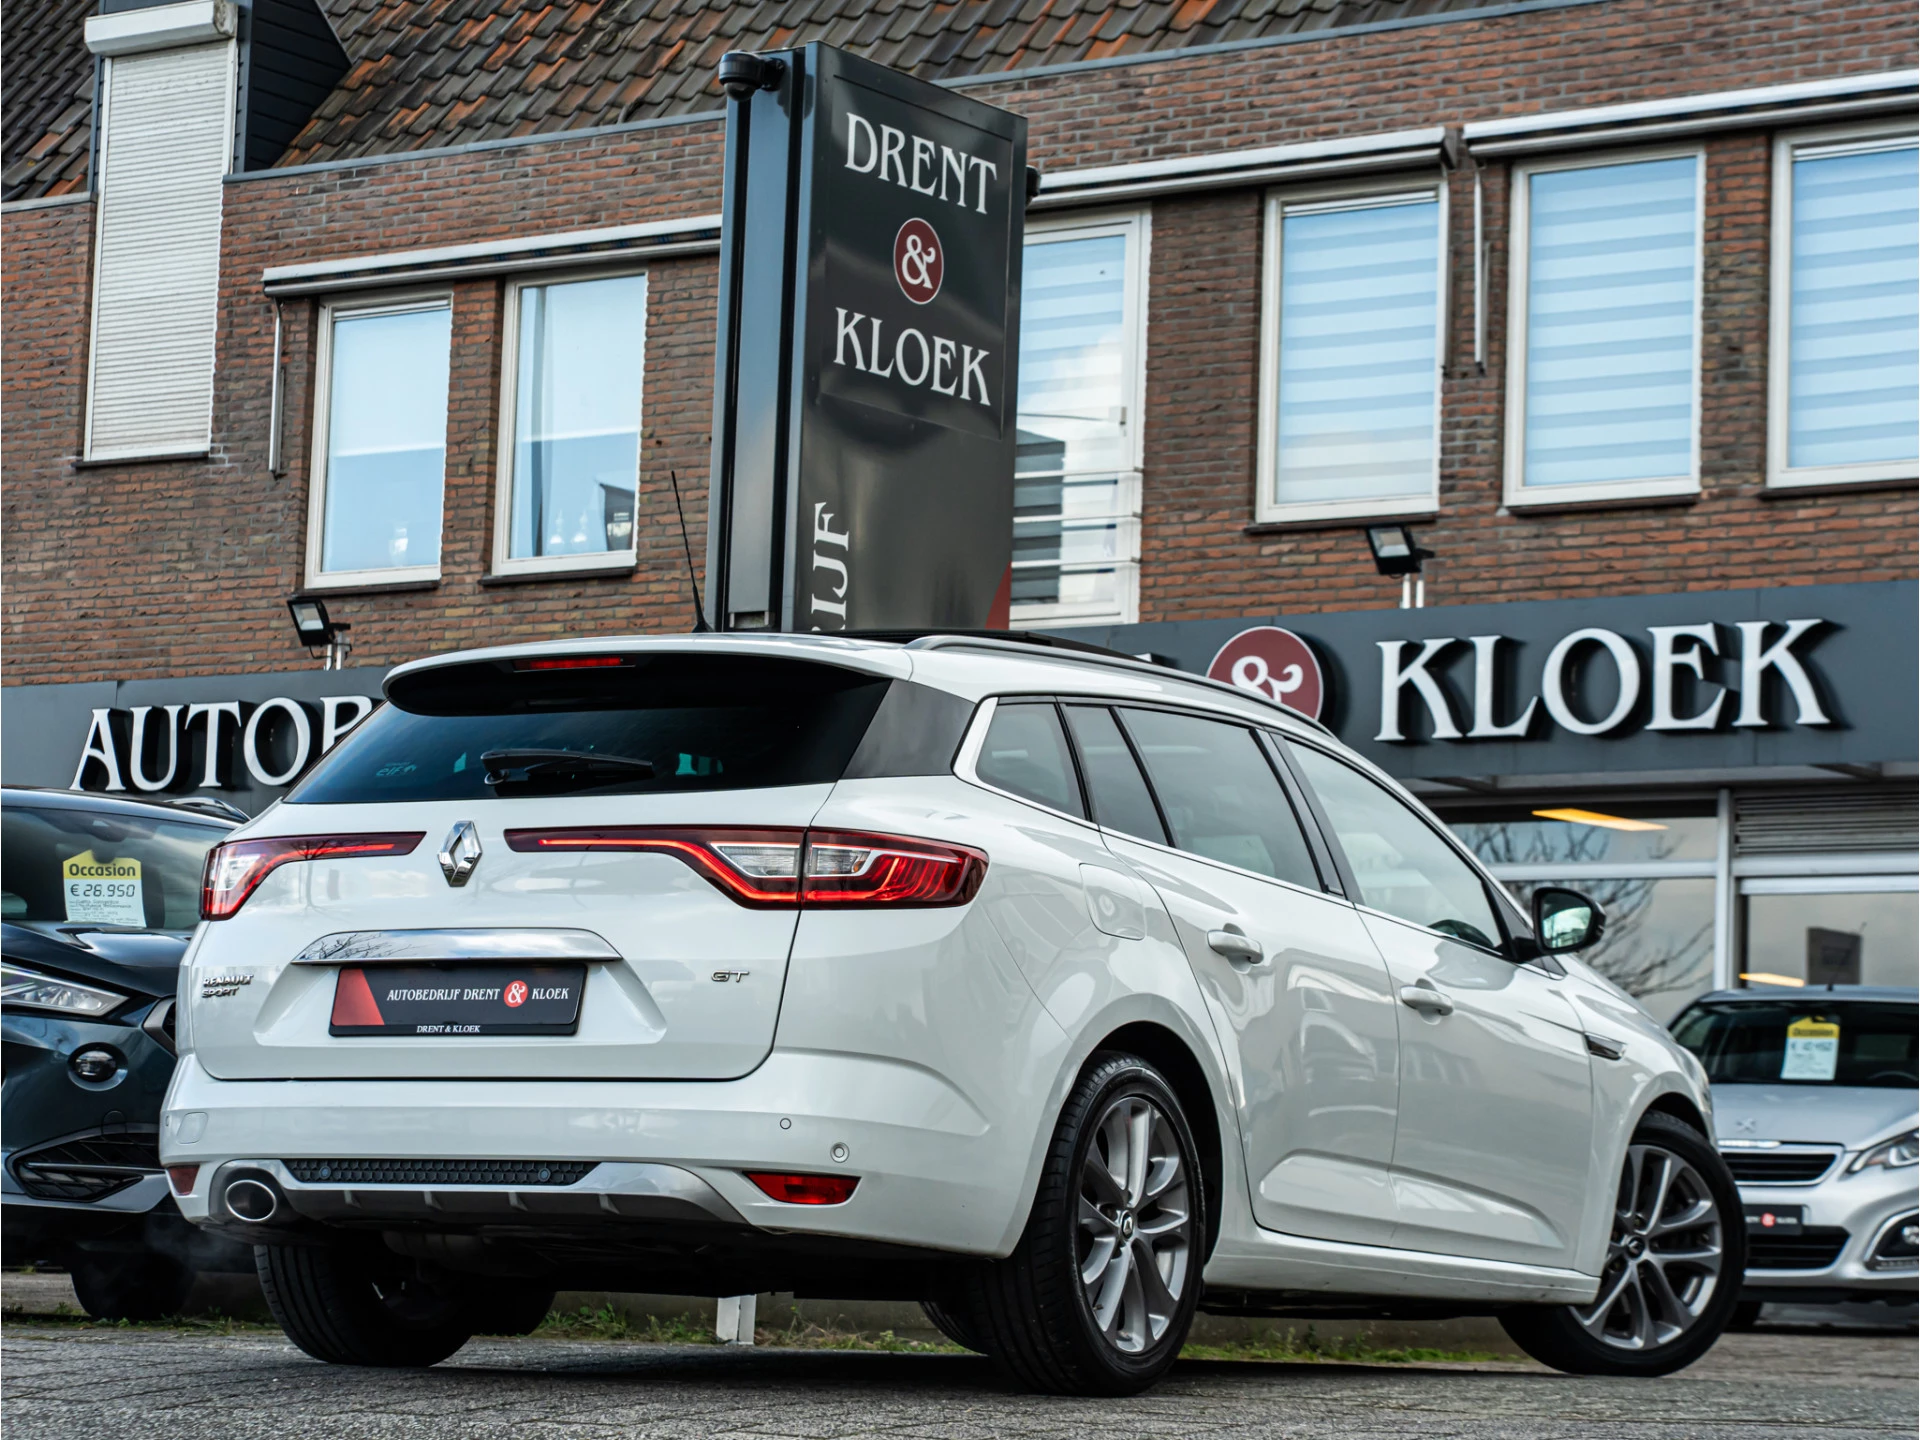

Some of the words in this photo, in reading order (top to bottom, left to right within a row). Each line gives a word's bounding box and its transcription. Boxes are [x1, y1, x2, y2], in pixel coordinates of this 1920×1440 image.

[844, 112, 997, 215] DRENT
[900, 234, 936, 289] &
[833, 306, 991, 406] KLOEK
[810, 501, 849, 631] IJF
[1374, 618, 1832, 741] KLOEK
[69, 863, 136, 877] Occasion
[203, 974, 254, 987] RENAULT
[711, 969, 750, 983] GT
[201, 986, 240, 999] SPORT
[386, 988, 461, 1001] AUTOBEDRIJF
[463, 988, 501, 1001] DRENT
[532, 988, 570, 1000] KLOEK
[416, 1025, 443, 1034] DRENT
[452, 1025, 481, 1034] KLOEK
